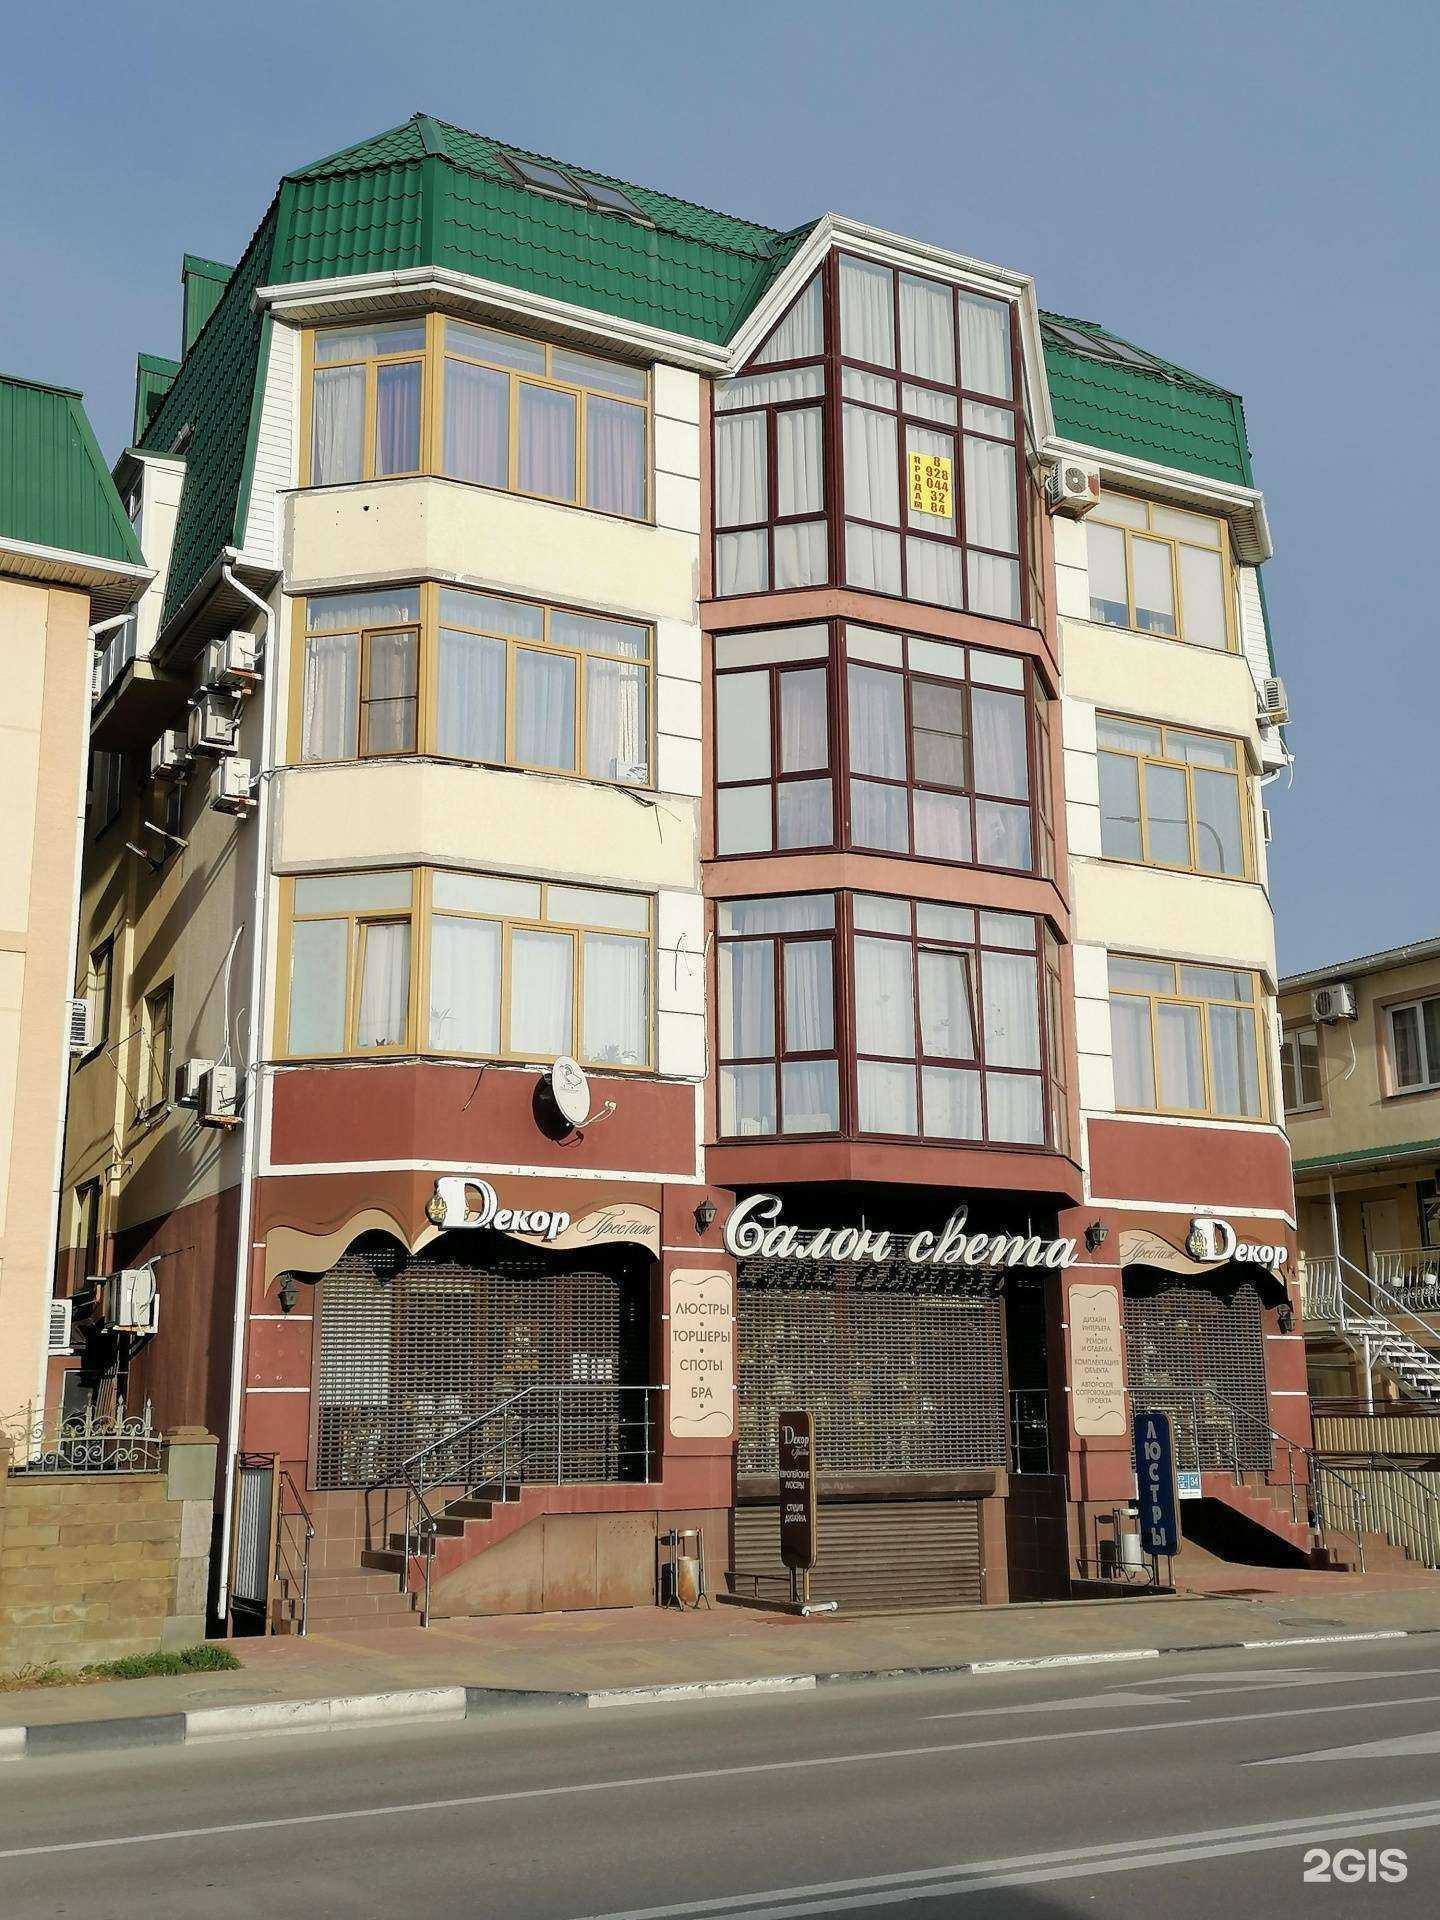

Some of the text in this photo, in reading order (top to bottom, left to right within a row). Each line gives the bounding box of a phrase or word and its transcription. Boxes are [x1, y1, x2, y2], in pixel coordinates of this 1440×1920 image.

[926, 466, 948, 480] 928
[926, 478, 948, 492] 044
[931, 491, 945, 503] 32
[931, 502, 945, 514] 84
[576, 1209, 655, 1241] Престиж
[723, 1193, 1079, 1268] Салон света
[675, 1302, 730, 1316] ЛЮСТРЫ
[672, 1329, 731, 1343] ТОРШЕРЫ
[679, 1359, 723, 1372] СПОТЫ
[691, 1386, 713, 1399] БРА
[1144, 1420, 1168, 1547] ЛЮСТРЫ
